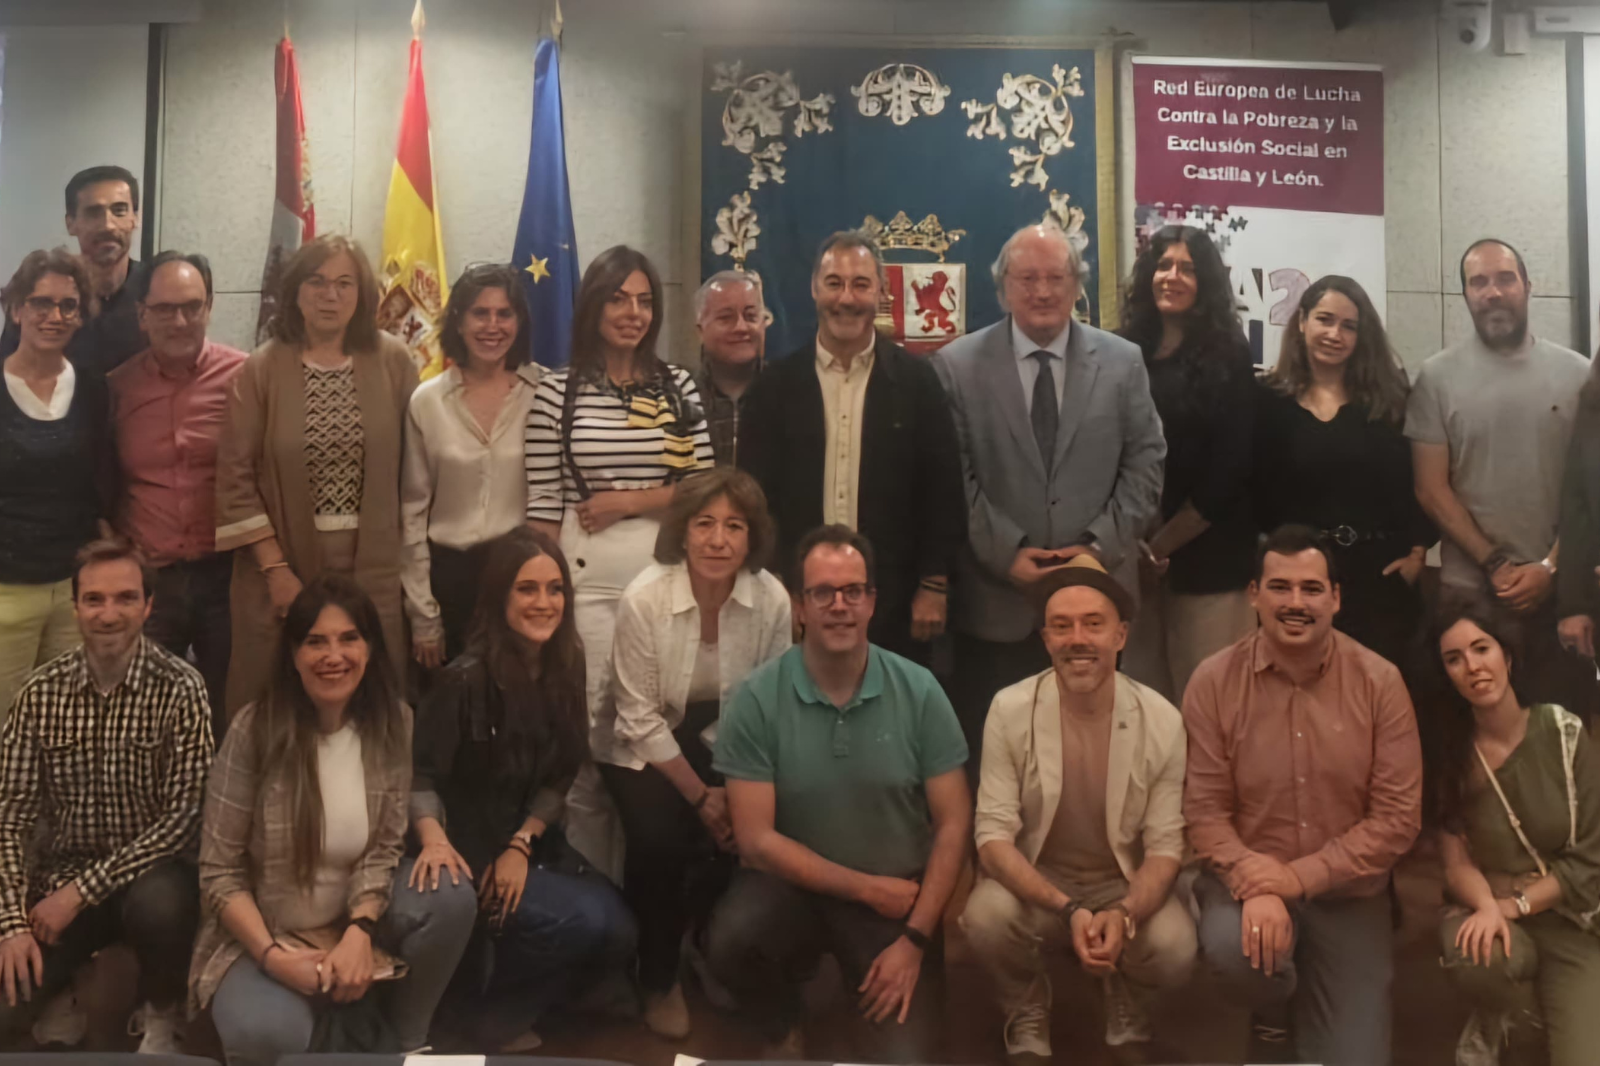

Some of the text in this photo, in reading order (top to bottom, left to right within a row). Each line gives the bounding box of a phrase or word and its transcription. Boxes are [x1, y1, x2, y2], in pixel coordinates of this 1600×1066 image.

[1194, 81, 1269, 101] Europea
[1275, 84, 1297, 100] de
[1303, 85, 1361, 102] Lucha
[1157, 107, 1358, 134] Contra la Pobreza y la
[1167, 135, 1347, 159] Exclusión Social en
[1183, 164, 1324, 188] Castilla y León.
